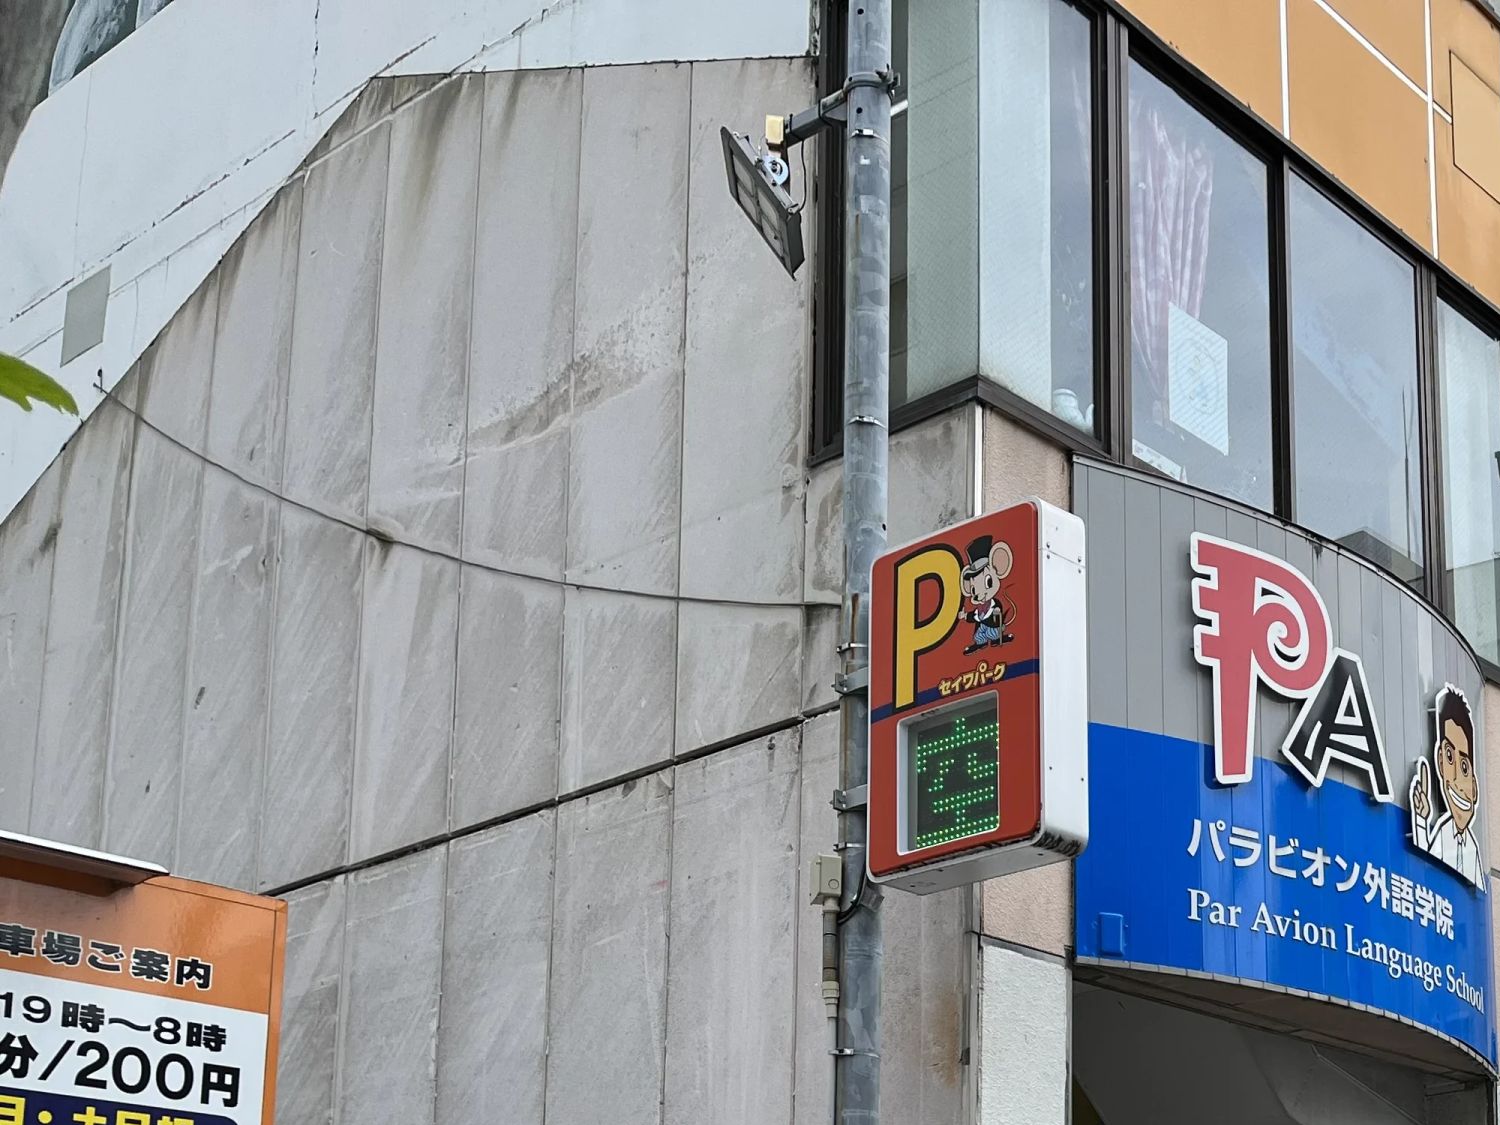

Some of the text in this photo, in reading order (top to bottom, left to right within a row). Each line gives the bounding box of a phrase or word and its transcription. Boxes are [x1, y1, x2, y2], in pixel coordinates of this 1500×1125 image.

[893, 543, 964, 710] P
[937, 659, 1007, 697] セイワパーク
[1186, 817, 1455, 942] パラビオン外語学院
[1186, 887, 1485, 1015] Par Avion Language School
